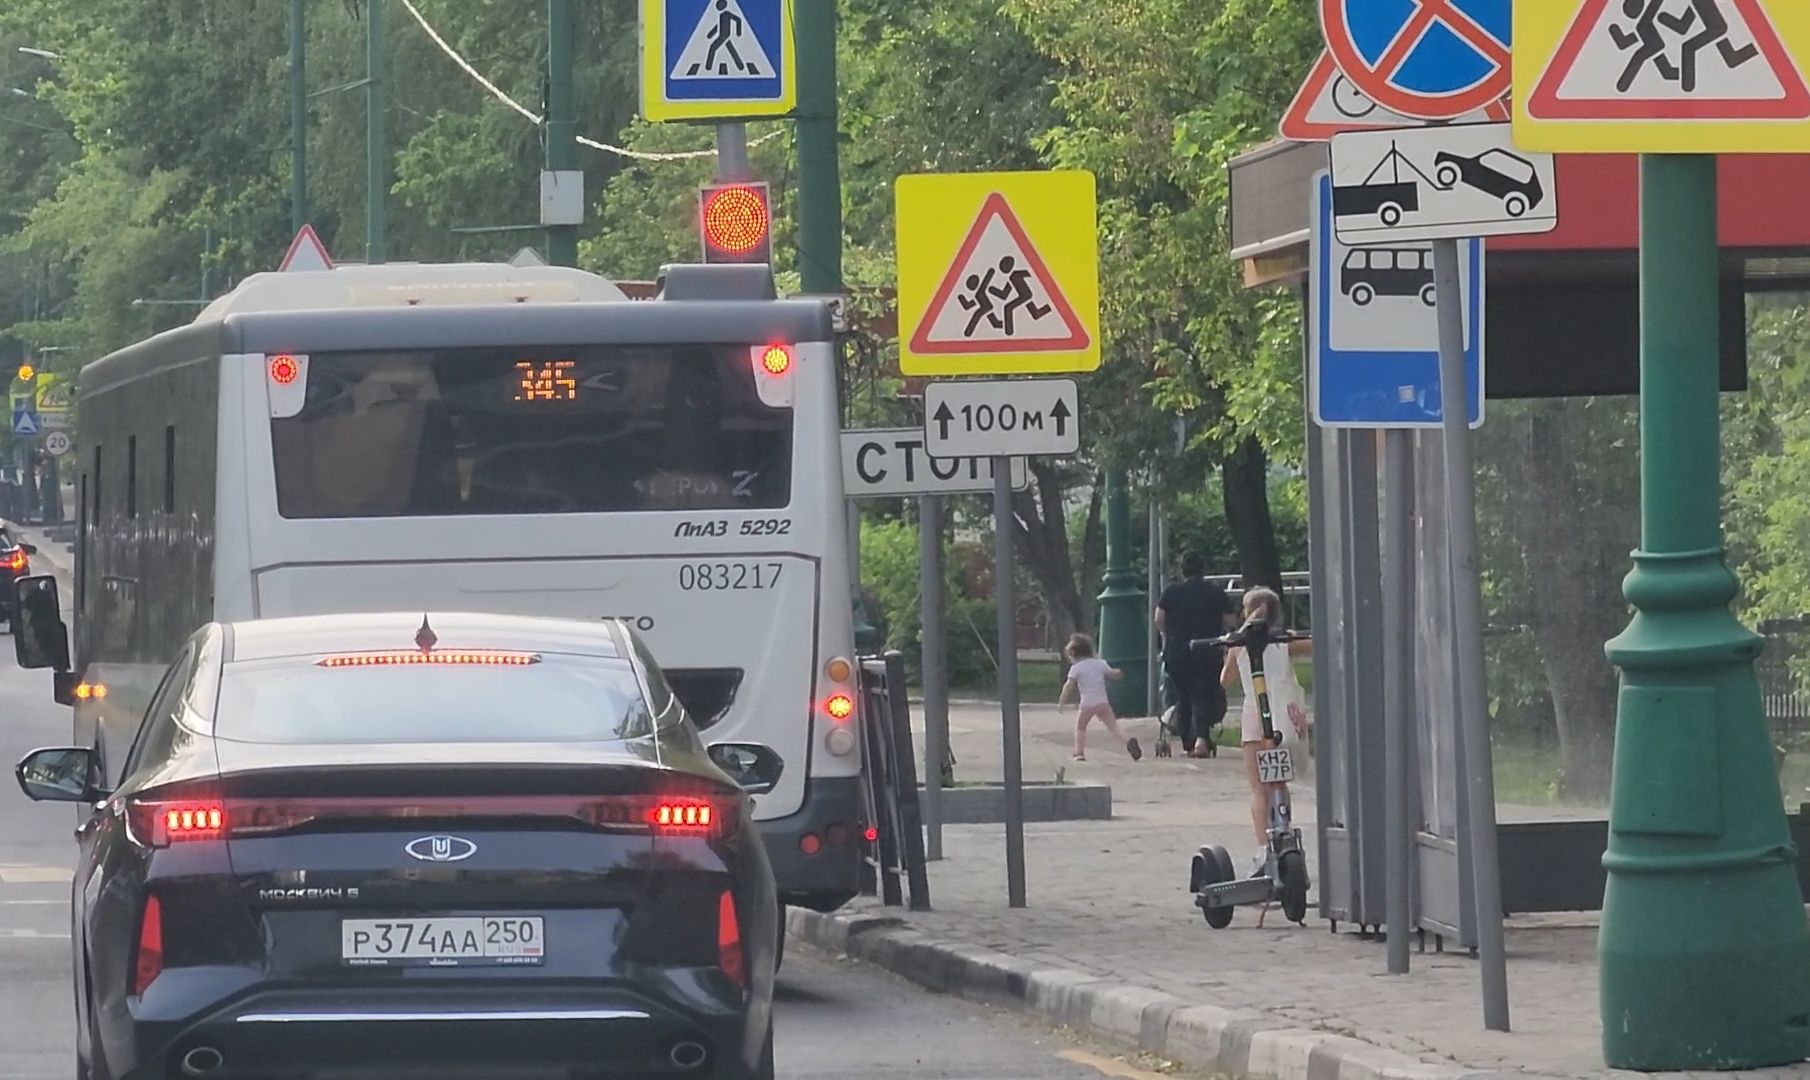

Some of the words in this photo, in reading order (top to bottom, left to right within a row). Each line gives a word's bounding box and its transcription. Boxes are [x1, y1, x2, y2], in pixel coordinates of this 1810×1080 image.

[514, 360, 577, 400] 345
[50, 437, 66, 449] 20
[739, 518, 792, 535] 5292
[679, 562, 783, 591] 083217
[258, 888, 342, 900] МОСКВИЧ
[486, 920, 534, 944] 250
